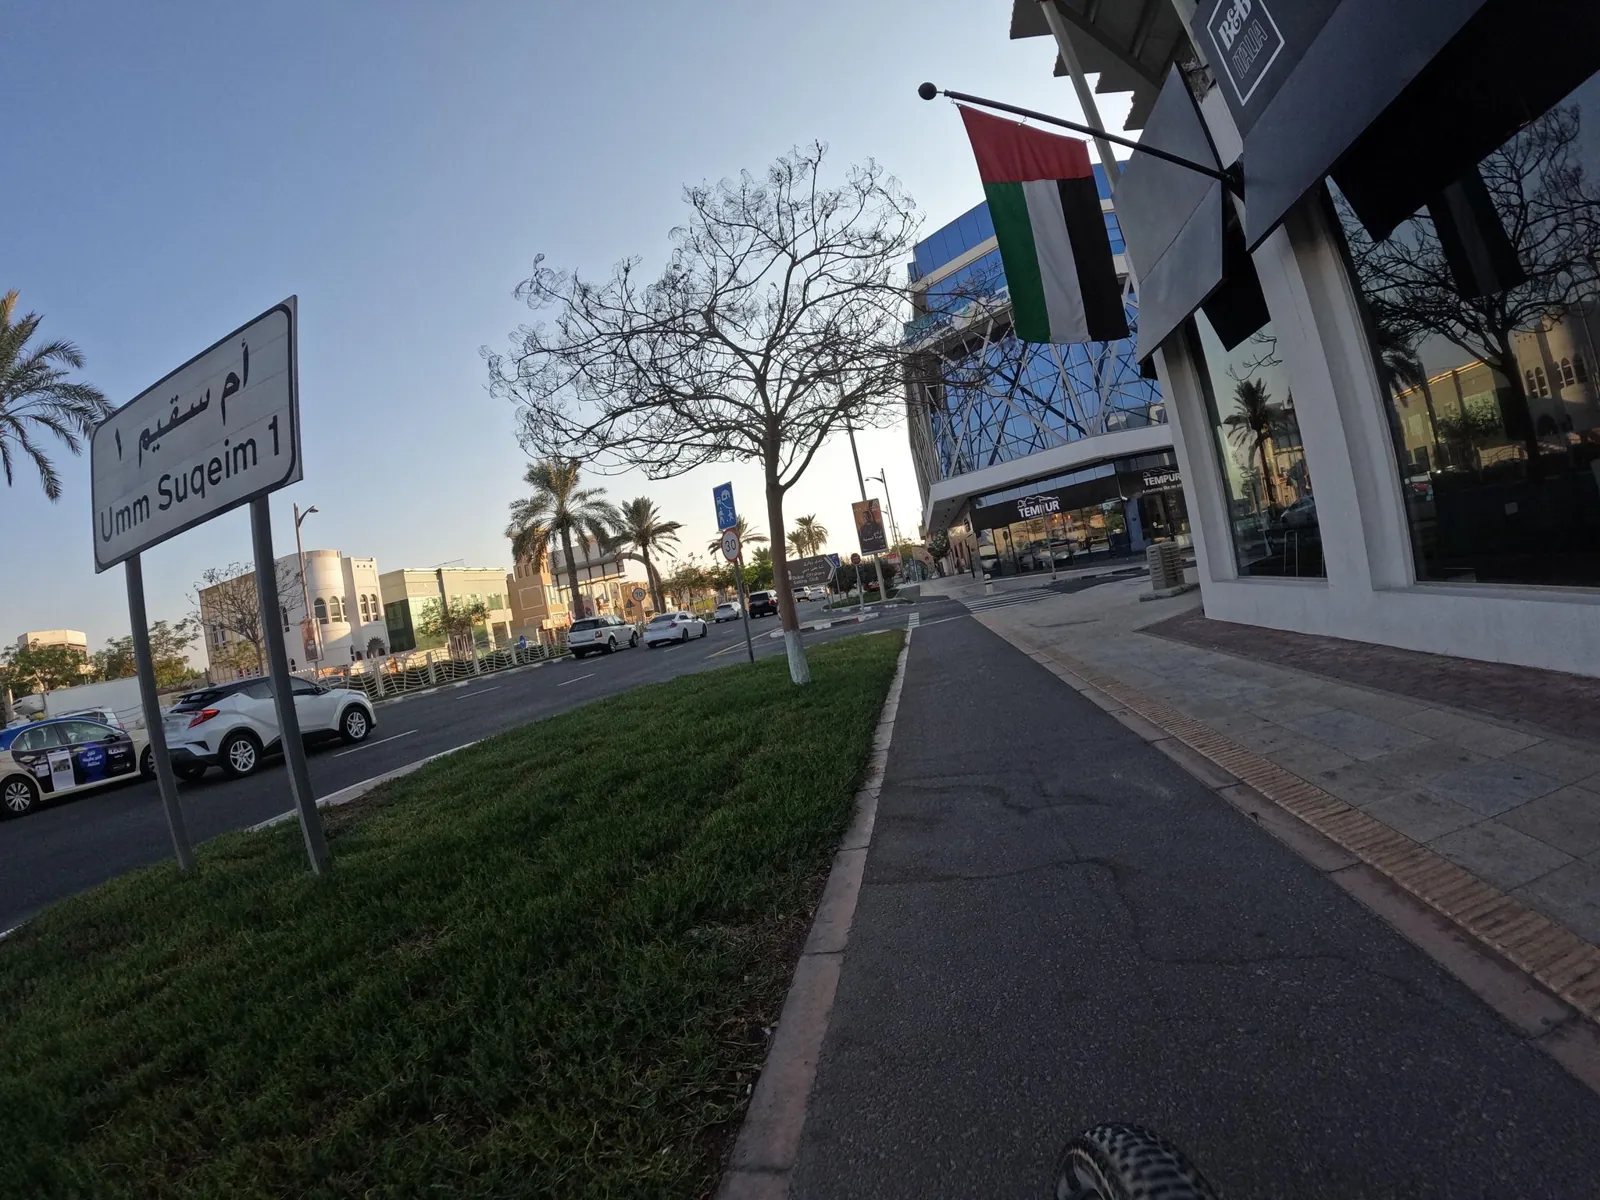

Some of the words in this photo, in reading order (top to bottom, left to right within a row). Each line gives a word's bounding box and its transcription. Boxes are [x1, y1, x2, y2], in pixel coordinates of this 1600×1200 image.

[1232, 19, 1268, 79] ITALIA
[221, 338, 249, 426] أم
[114, 427, 122, 461] ١
[138, 388, 210, 468] سقيم
[100, 495, 150, 543] Umm
[157, 437, 258, 511] Suqeim
[268, 415, 280, 456] 1
[1143, 472, 1181, 486] TEMPUR
[1018, 500, 1060, 518] TEMUR
[725, 539, 737, 552] 30
